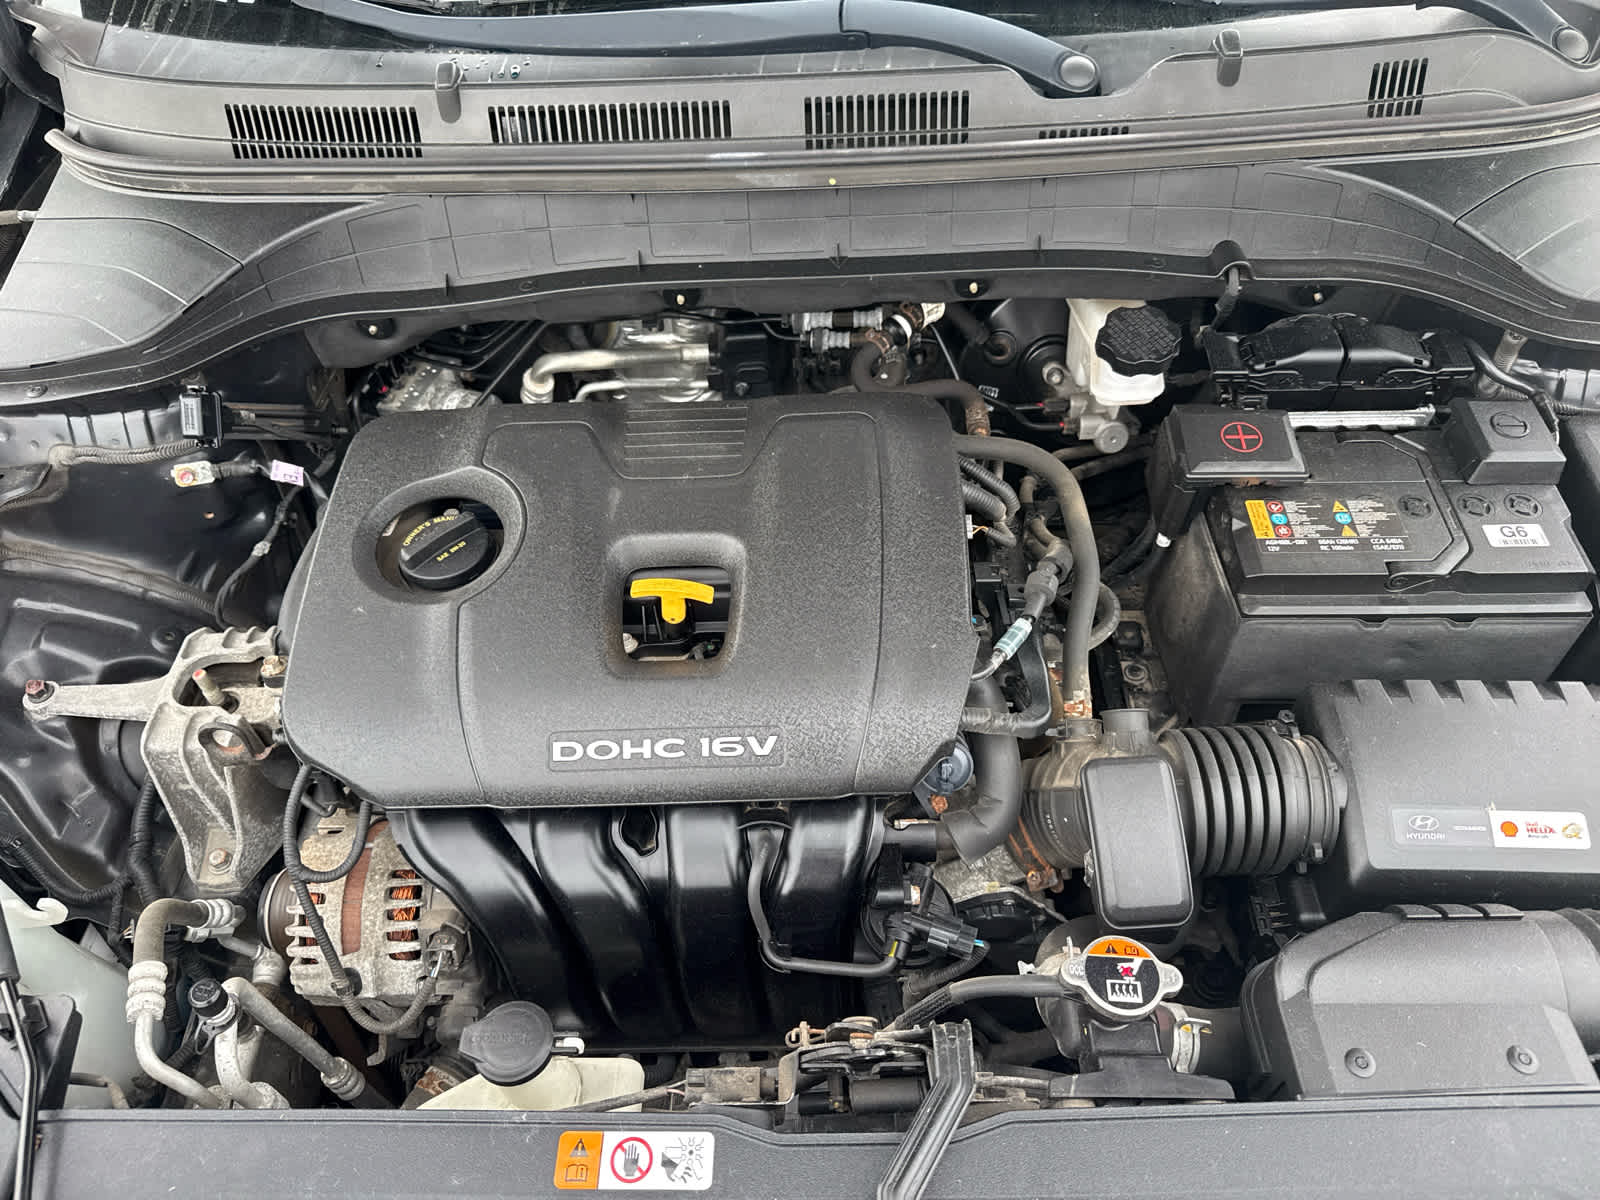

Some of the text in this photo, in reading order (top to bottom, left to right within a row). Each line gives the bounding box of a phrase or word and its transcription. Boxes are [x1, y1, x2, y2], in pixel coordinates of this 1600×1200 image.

[402, 521, 431, 546] OWNER'S
[1500, 525, 1528, 538] G6
[552, 735, 778, 761] DOHC 16V
[1406, 832, 1446, 841] HYUNDAI
[1526, 826, 1556, 834] HELIX
